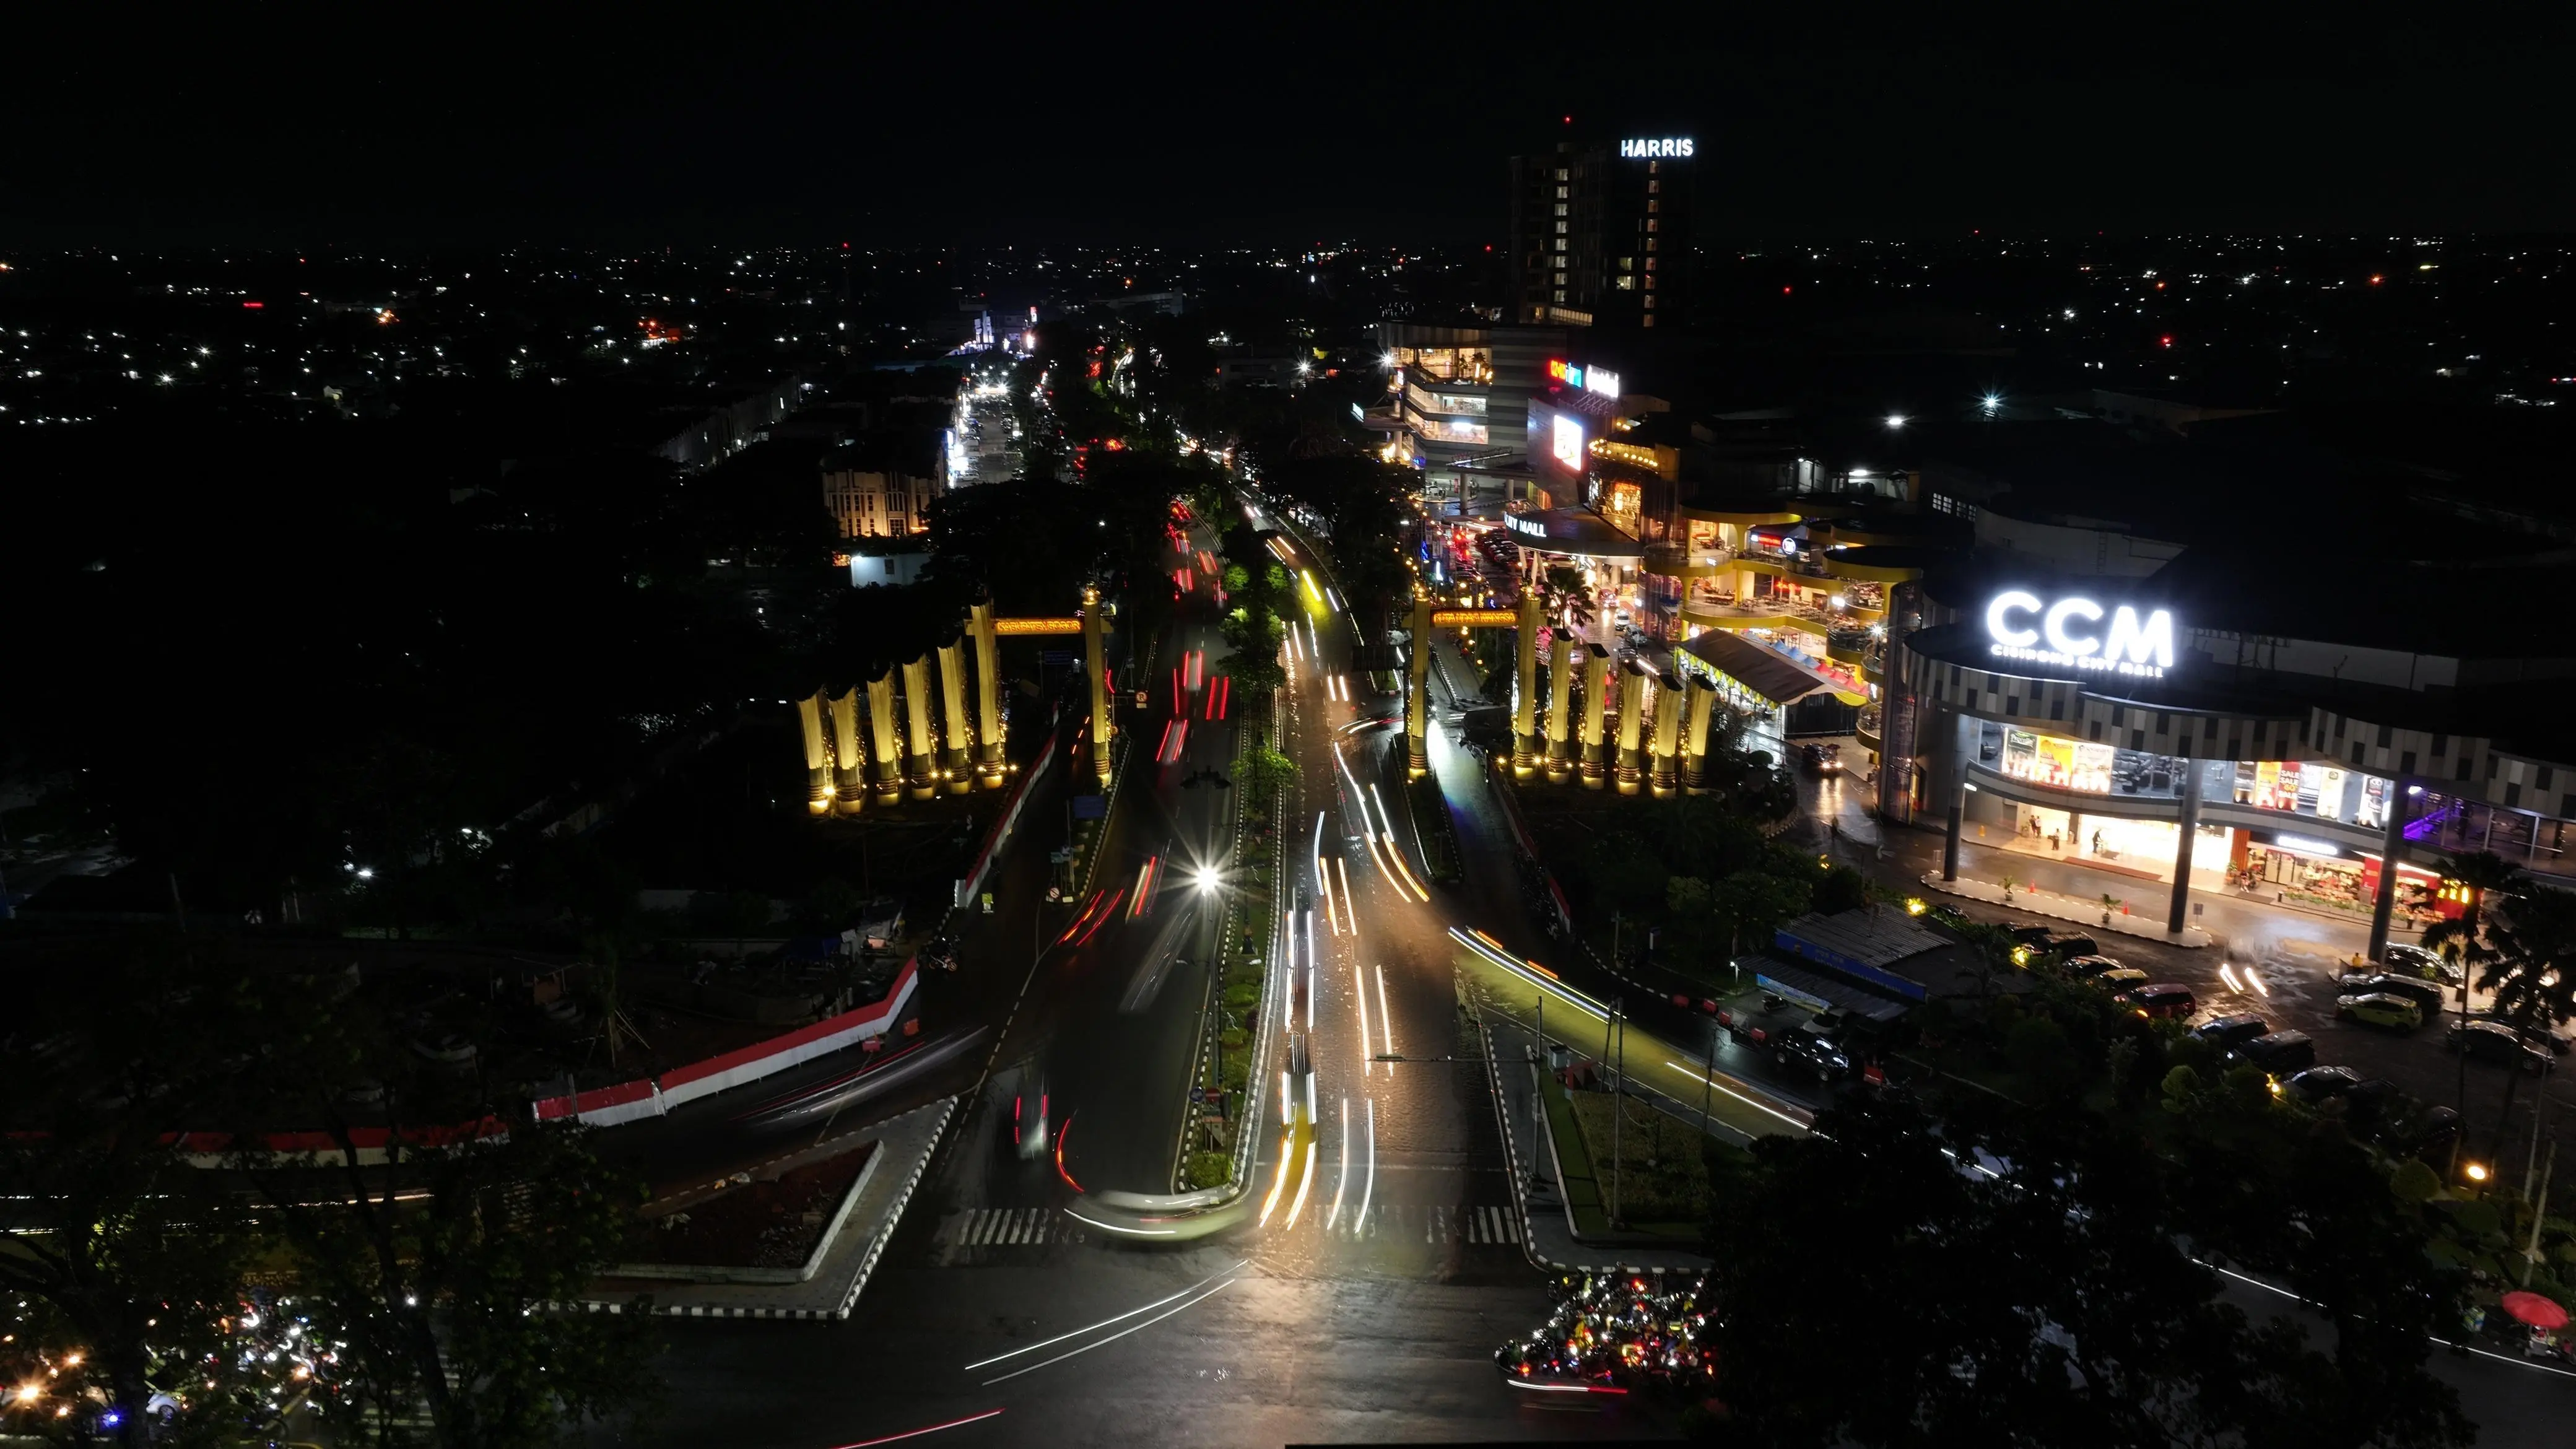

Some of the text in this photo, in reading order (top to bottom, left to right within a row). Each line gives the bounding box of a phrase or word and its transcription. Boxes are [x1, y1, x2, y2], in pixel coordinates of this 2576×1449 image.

[1621, 138, 1694, 158] HARRIS
[1520, 520, 1546, 537] MALL
[997, 620, 1081, 630] KABUPATEN BOGOR
[1987, 591, 2173, 668] CCM
[1990, 644, 2163, 678] CIBINONG CITY MALL
[2279, 777, 2299, 785] SALE
[2280, 770, 2300, 779] SALE
